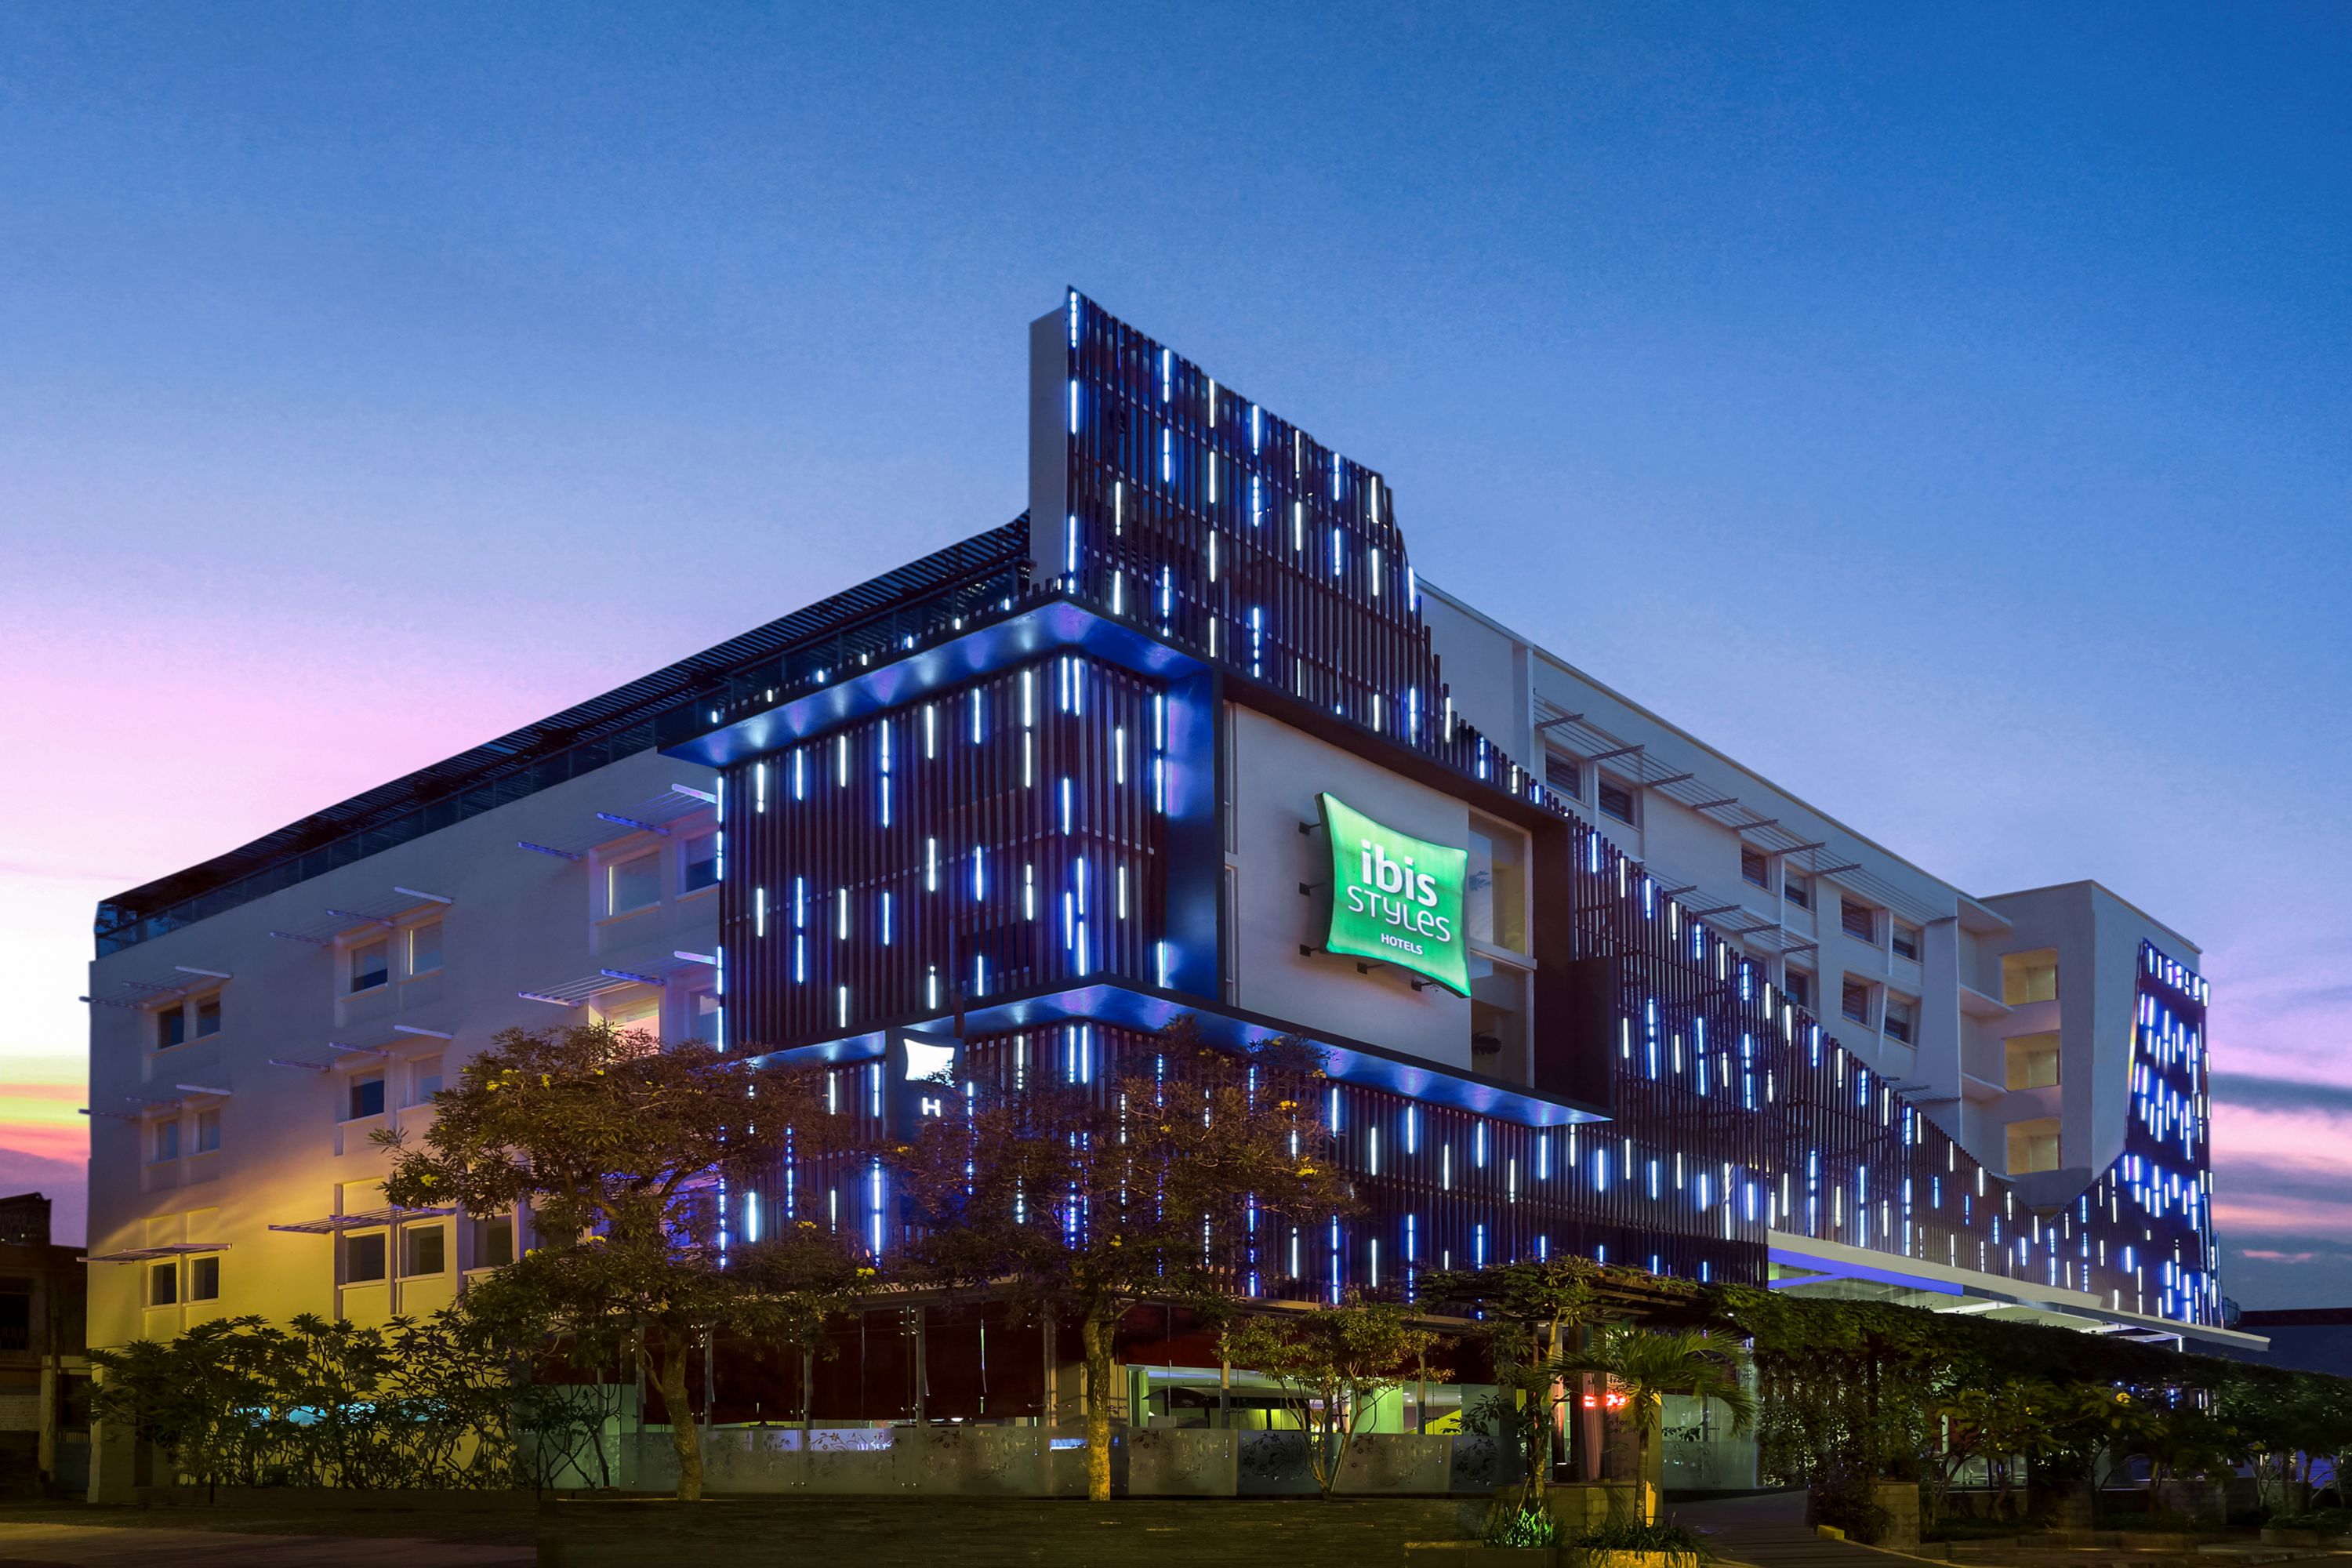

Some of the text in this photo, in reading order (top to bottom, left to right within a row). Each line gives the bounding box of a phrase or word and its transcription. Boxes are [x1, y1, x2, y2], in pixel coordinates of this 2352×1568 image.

[1361, 838, 1438, 907] ibis
[1381, 932, 1423, 955] HOTELS
[922, 1097, 941, 1117] H
